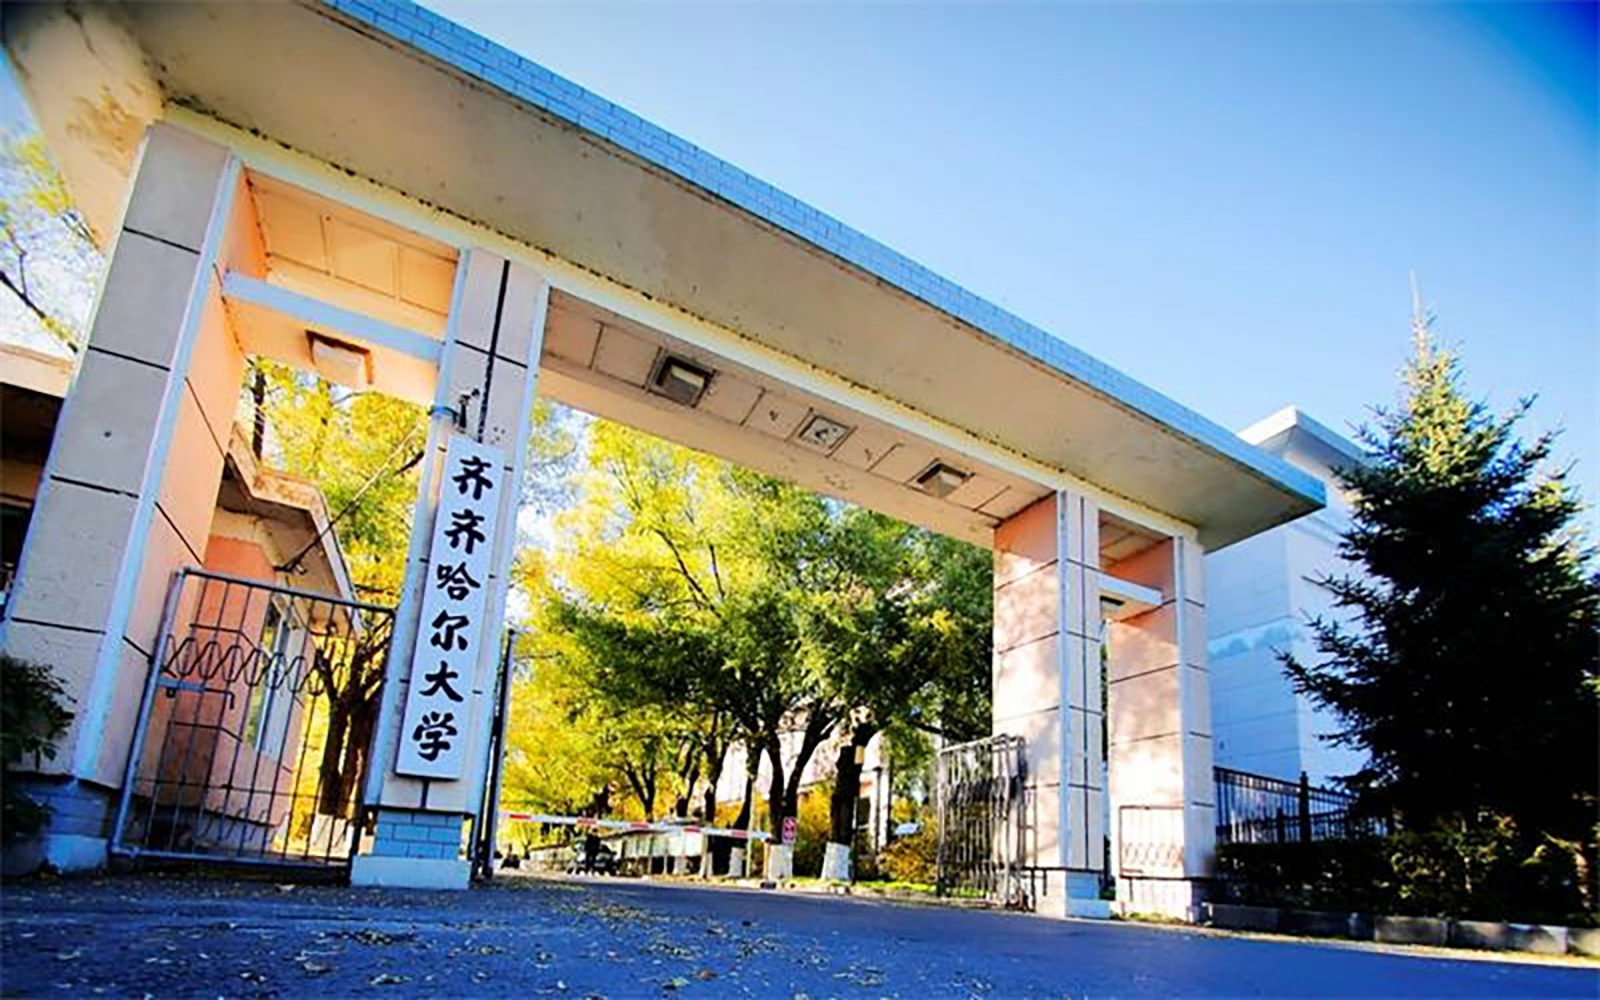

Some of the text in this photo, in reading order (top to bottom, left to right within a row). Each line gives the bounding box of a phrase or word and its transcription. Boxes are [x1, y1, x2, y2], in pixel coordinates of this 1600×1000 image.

[412, 456, 493, 762] 齐齐哈尔大学
